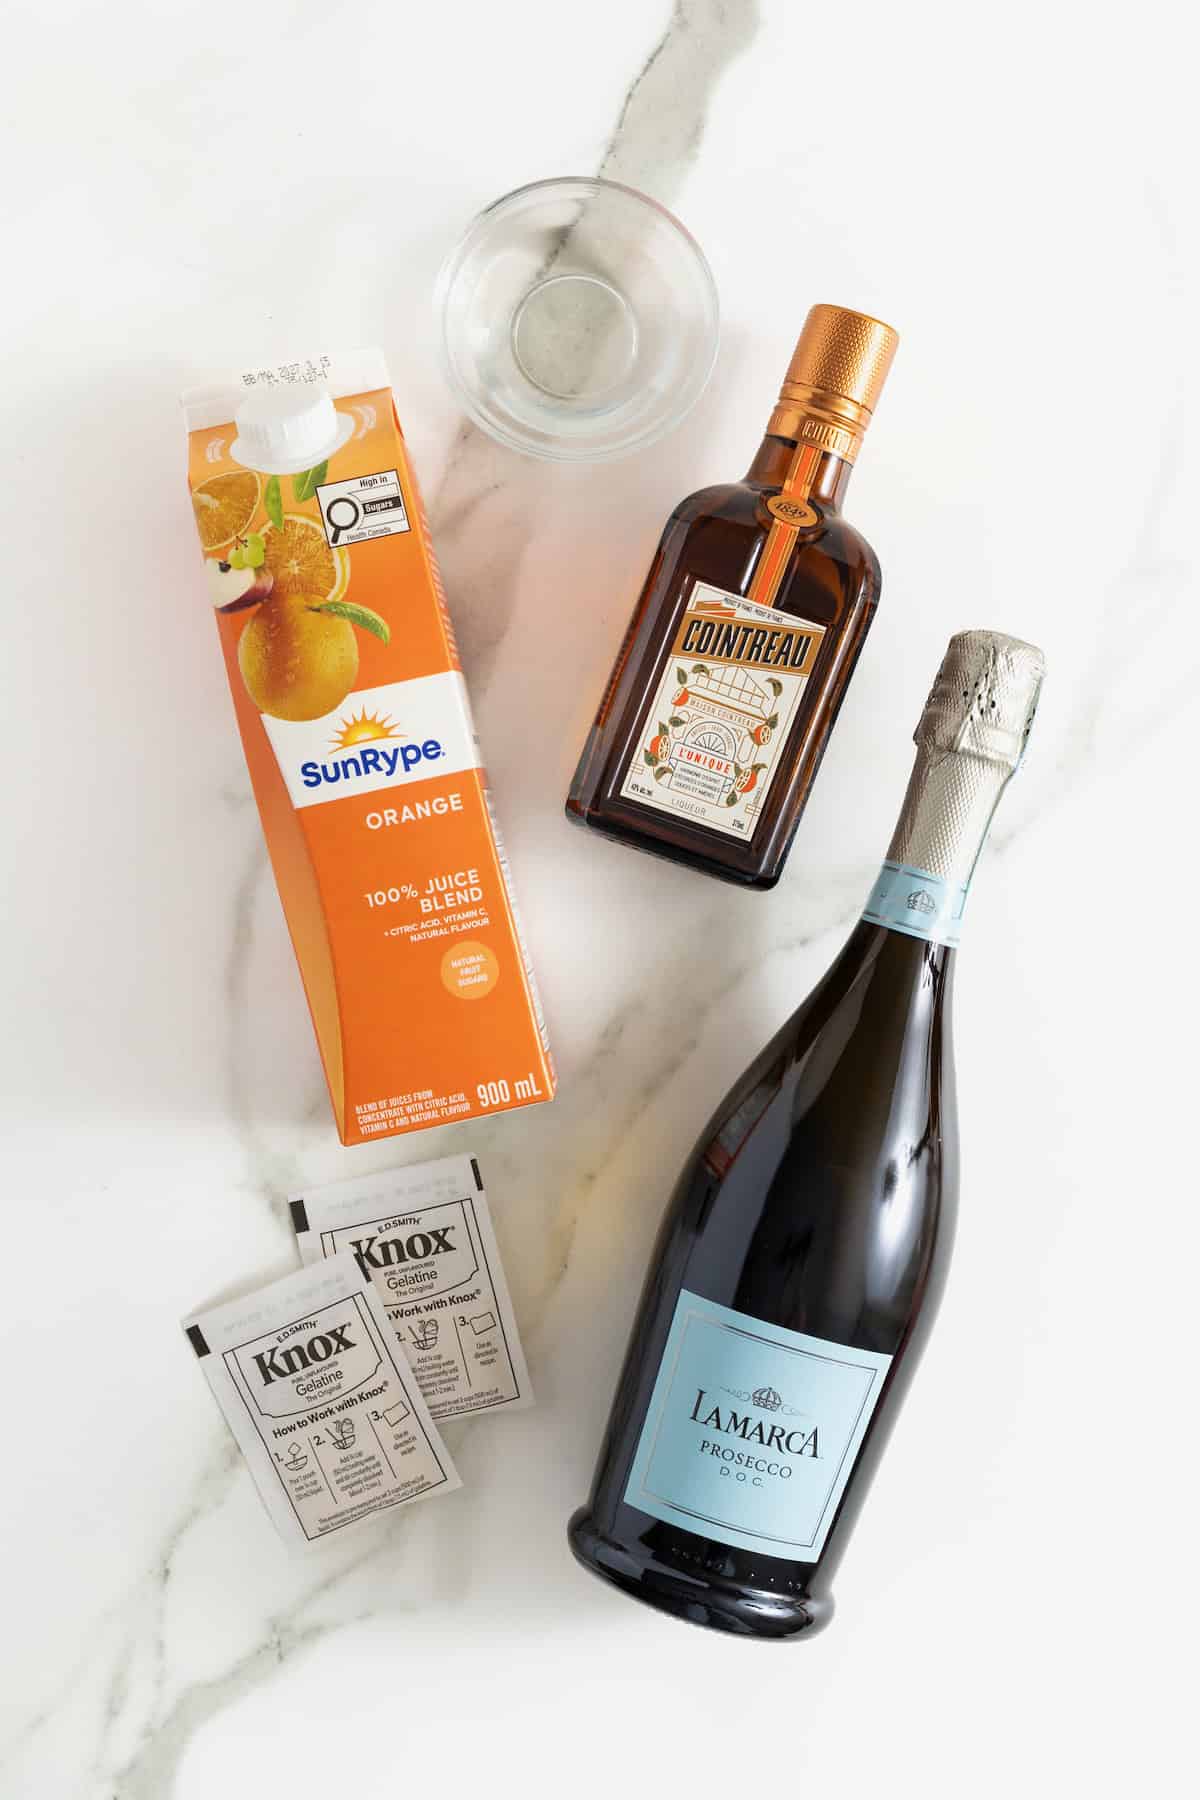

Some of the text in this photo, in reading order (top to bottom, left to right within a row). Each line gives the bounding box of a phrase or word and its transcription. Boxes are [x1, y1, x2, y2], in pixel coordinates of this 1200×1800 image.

[359, 475, 387, 488] High in
[364, 499, 393, 513] Sugars
[774, 502, 808, 519] 1849
[682, 619, 811, 668] COINTREAU
[301, 740, 442, 787] SunRype
[678, 748, 731, 773] L'UNIQUE
[367, 794, 463, 829] ORANGE
[365, 870, 480, 907] 100% JUICE
[420, 888, 483, 912] BLEND
[389, 924, 418, 935] CITRIC
[443, 910, 477, 922] VITAMIN
[409, 918, 489, 941] NATURAL FLAVOUR
[477, 1073, 542, 1108] 900 mL
[386, 1268, 438, 1289] Gelatine
[395, 1283, 434, 1297] The Original
[395, 1305, 421, 1318] Work
[424, 1298, 447, 1310] with
[457, 1315, 469, 1326] 3.
[294, 1368, 344, 1396] Gelatine
[305, 1383, 342, 1402] The Original
[272, 1422, 297, 1438] How
[295, 1416, 308, 1428] to
[306, 1405, 335, 1423] Work
[333, 1395, 357, 1411] with
[369, 1409, 383, 1421] 3.
[312, 1433, 326, 1445] 2.
[700, 1440, 792, 1479] PROSECCO
